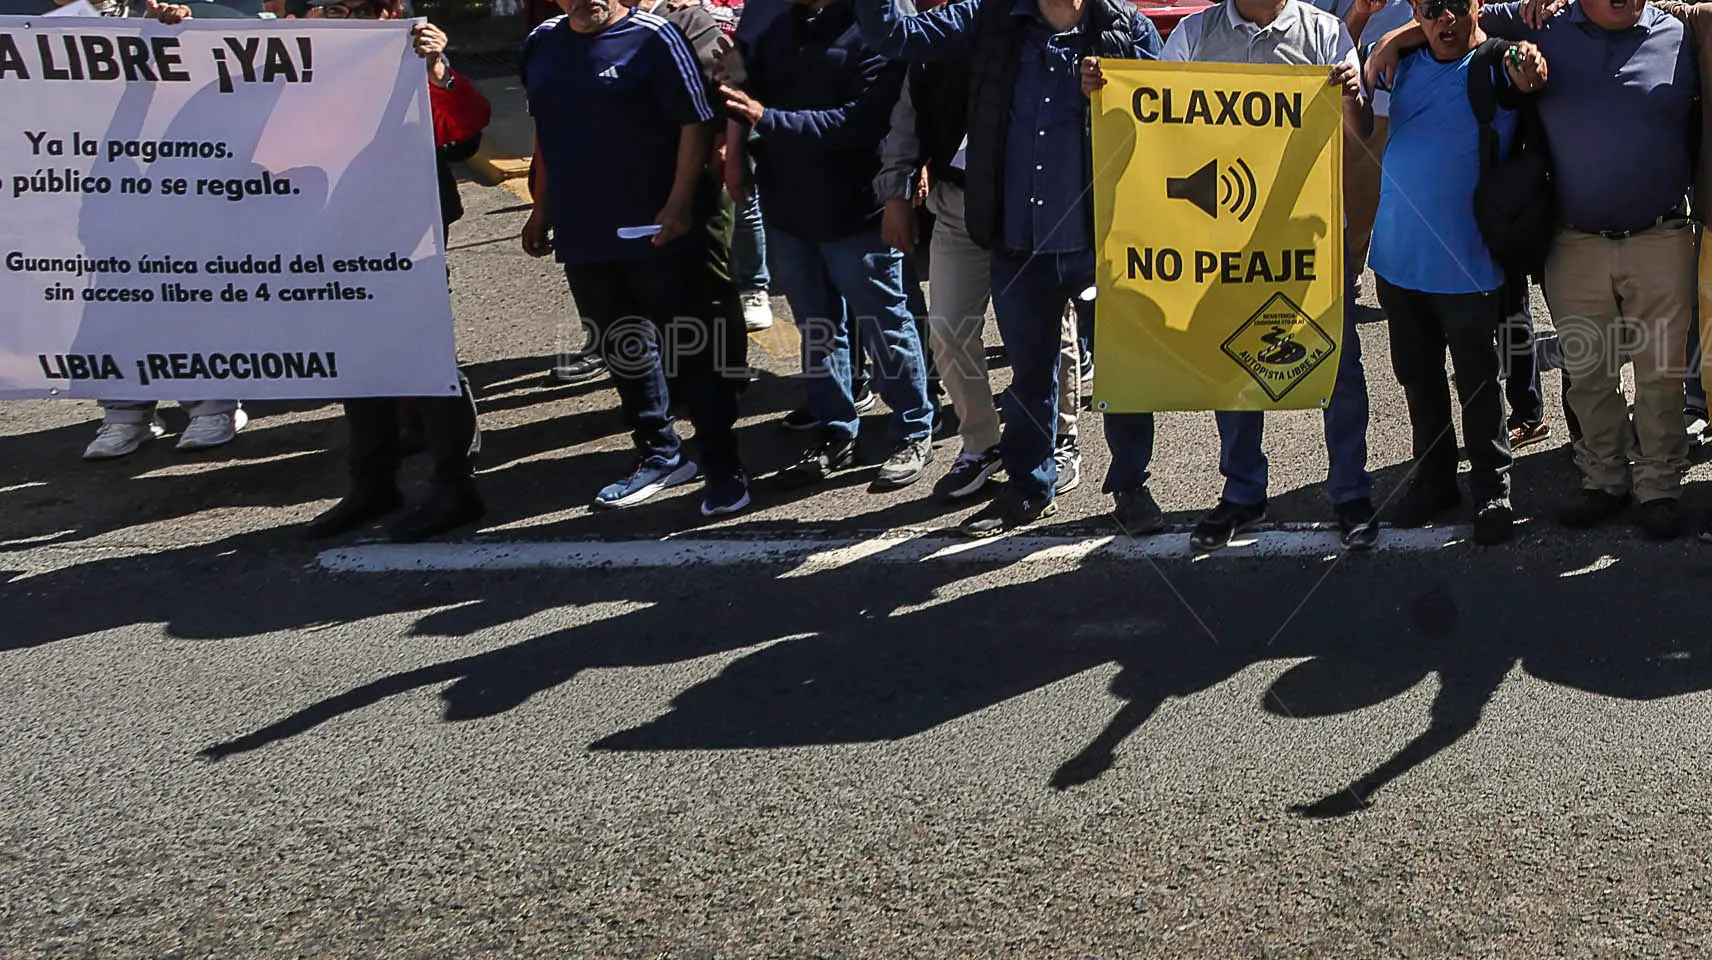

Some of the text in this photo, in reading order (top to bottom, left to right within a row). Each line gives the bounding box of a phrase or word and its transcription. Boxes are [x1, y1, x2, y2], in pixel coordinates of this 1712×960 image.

[36, 34, 191, 82] LIBRE
[212, 36, 313, 93] ¡YA!
[1131, 86, 1302, 128] CLAXON
[24, 131, 233, 162] Ya la pagamos.
[13, 168, 111, 197] público
[121, 177, 152, 194] no
[161, 179, 187, 195] se
[198, 171, 300, 201] regala.
[6, 252, 413, 276] Guanajuato única ciudad del estado
[1127, 247, 1317, 284] NO PEAJE
[44, 282, 374, 302] sin acceso libre de 4 carriles.
[38, 351, 337, 385] LIBIA ¡REACCIONA!
[1239, 348, 1324, 380] AUTOPISTA LIBRE YA
